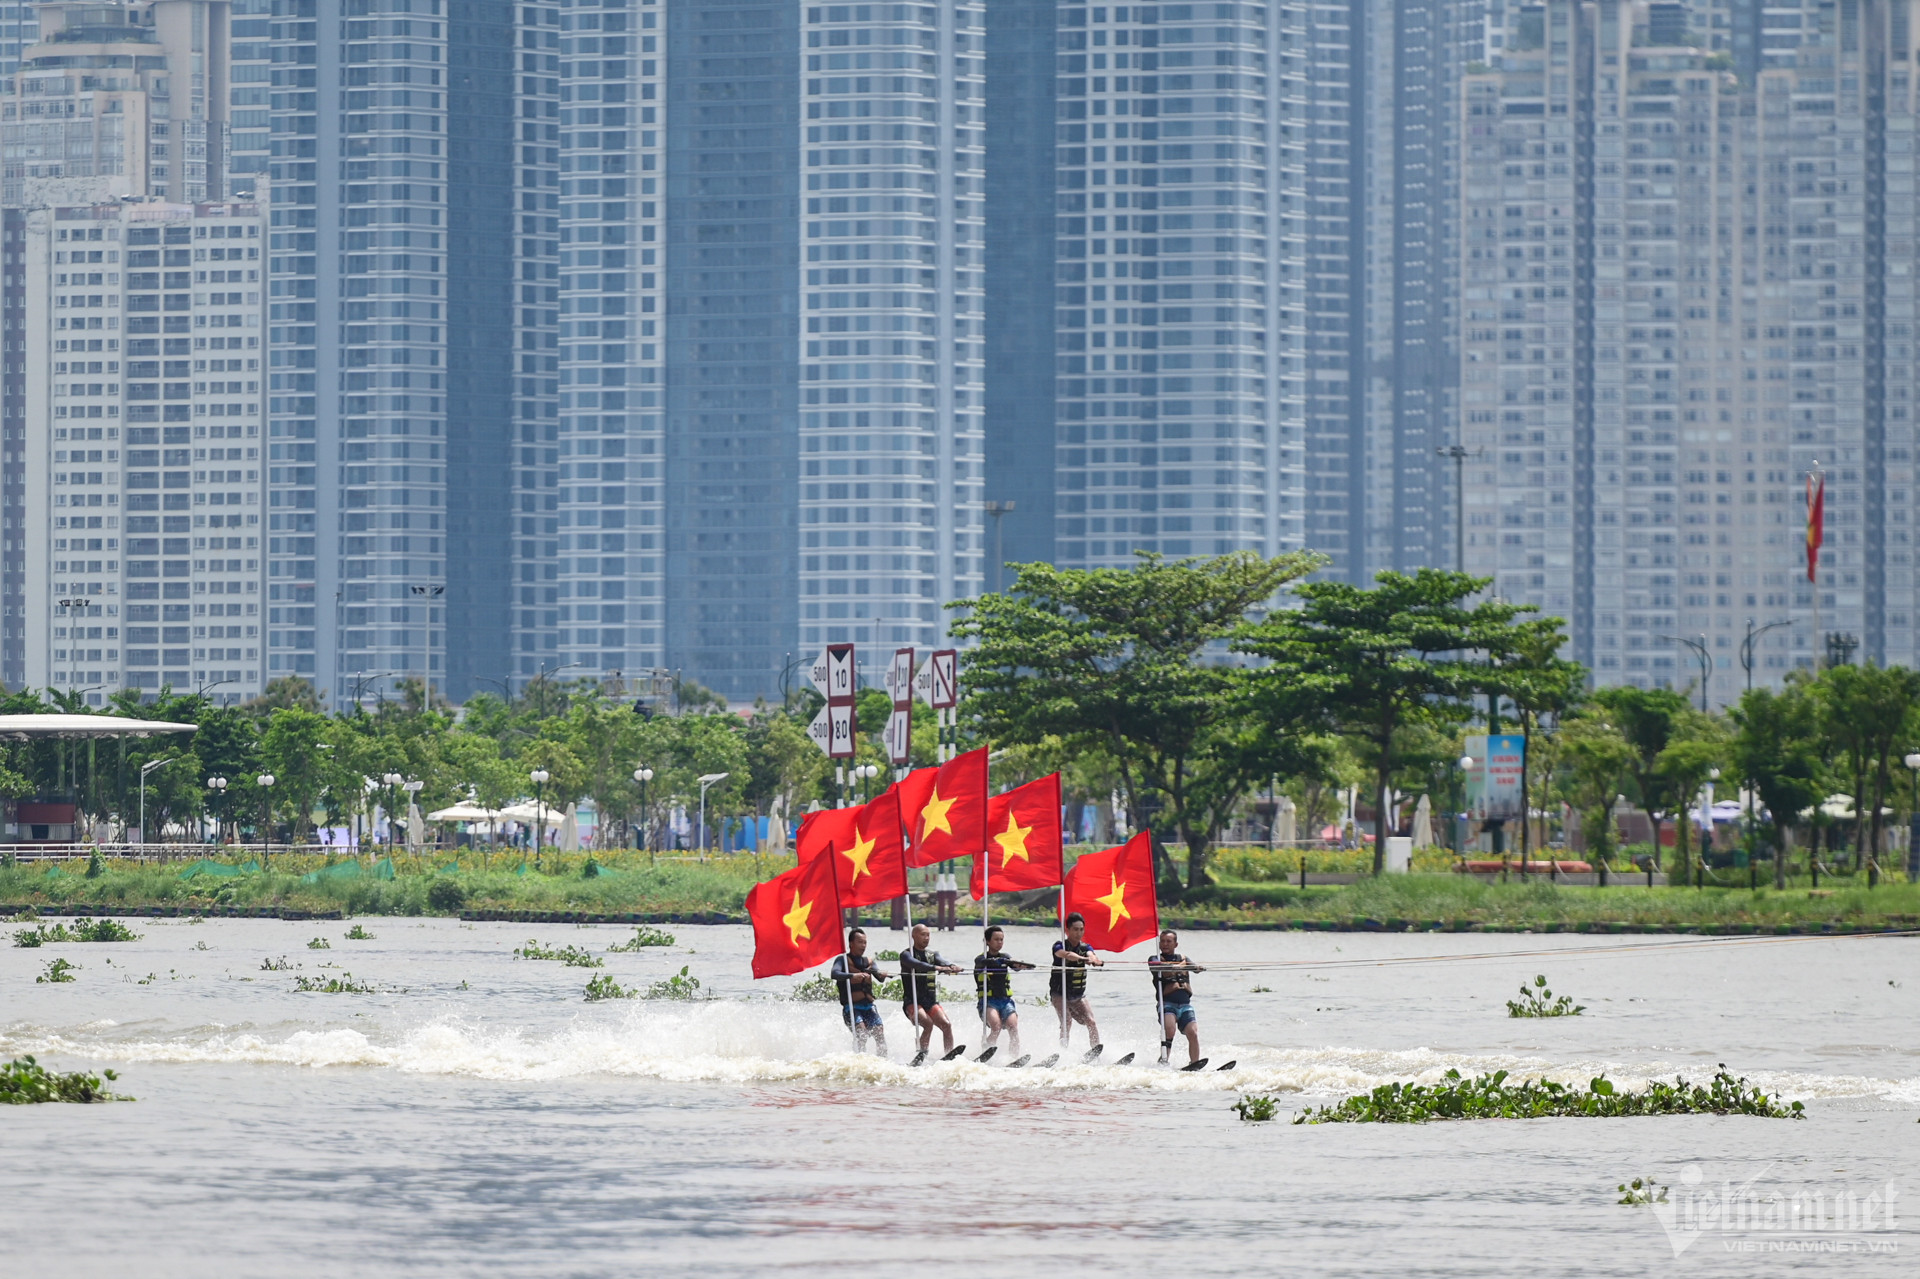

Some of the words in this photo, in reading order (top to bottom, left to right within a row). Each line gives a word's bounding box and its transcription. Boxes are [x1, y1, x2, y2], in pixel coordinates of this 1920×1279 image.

[814, 666, 827, 682] 500
[836, 668, 847, 688] 10
[918, 673, 931, 689] 500
[813, 722, 828, 738] 500
[836, 719, 848, 740] 80
